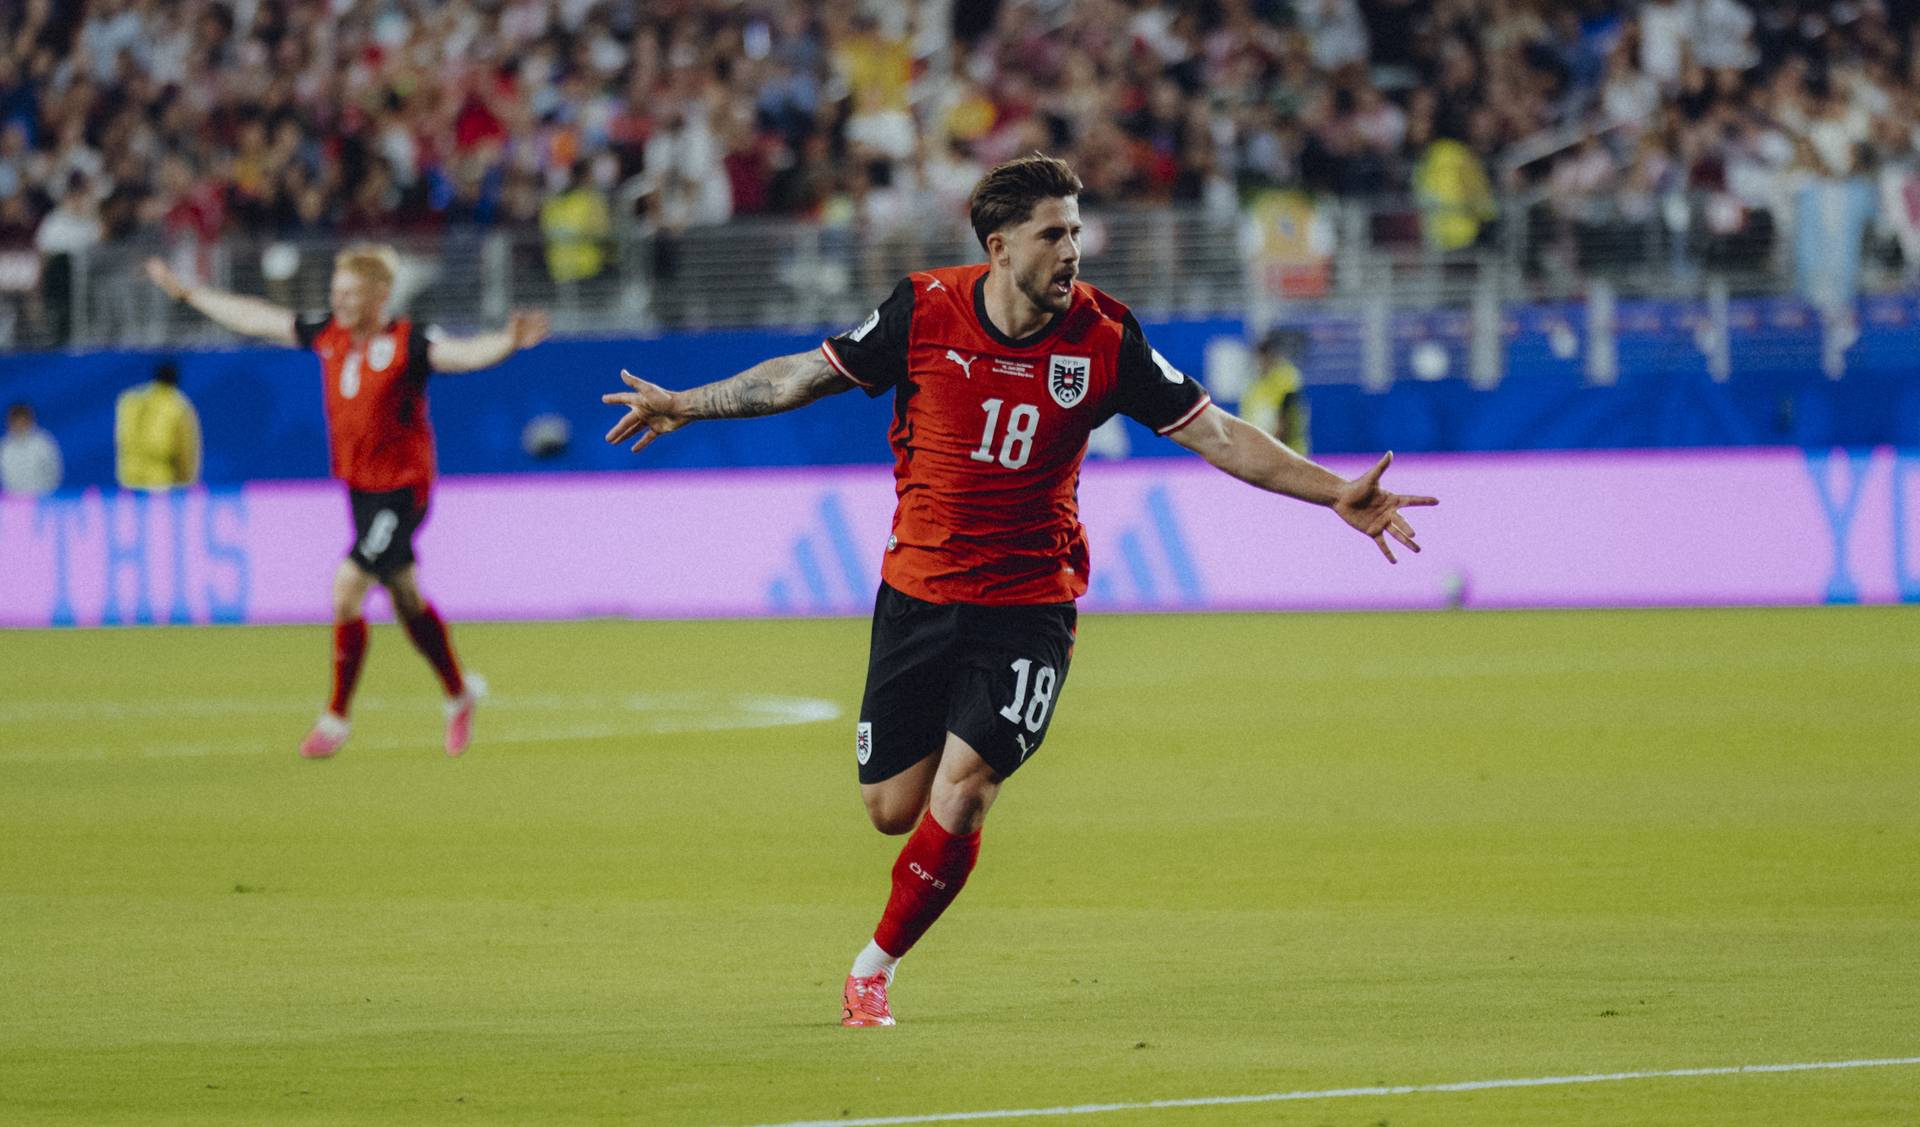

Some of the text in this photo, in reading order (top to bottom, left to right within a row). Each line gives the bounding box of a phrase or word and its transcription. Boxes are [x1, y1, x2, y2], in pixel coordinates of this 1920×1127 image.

[970, 398, 1040, 470] 18
[36, 487, 250, 627] THIS
[999, 657, 1057, 734] 18
[908, 862, 947, 890] ÖFB
